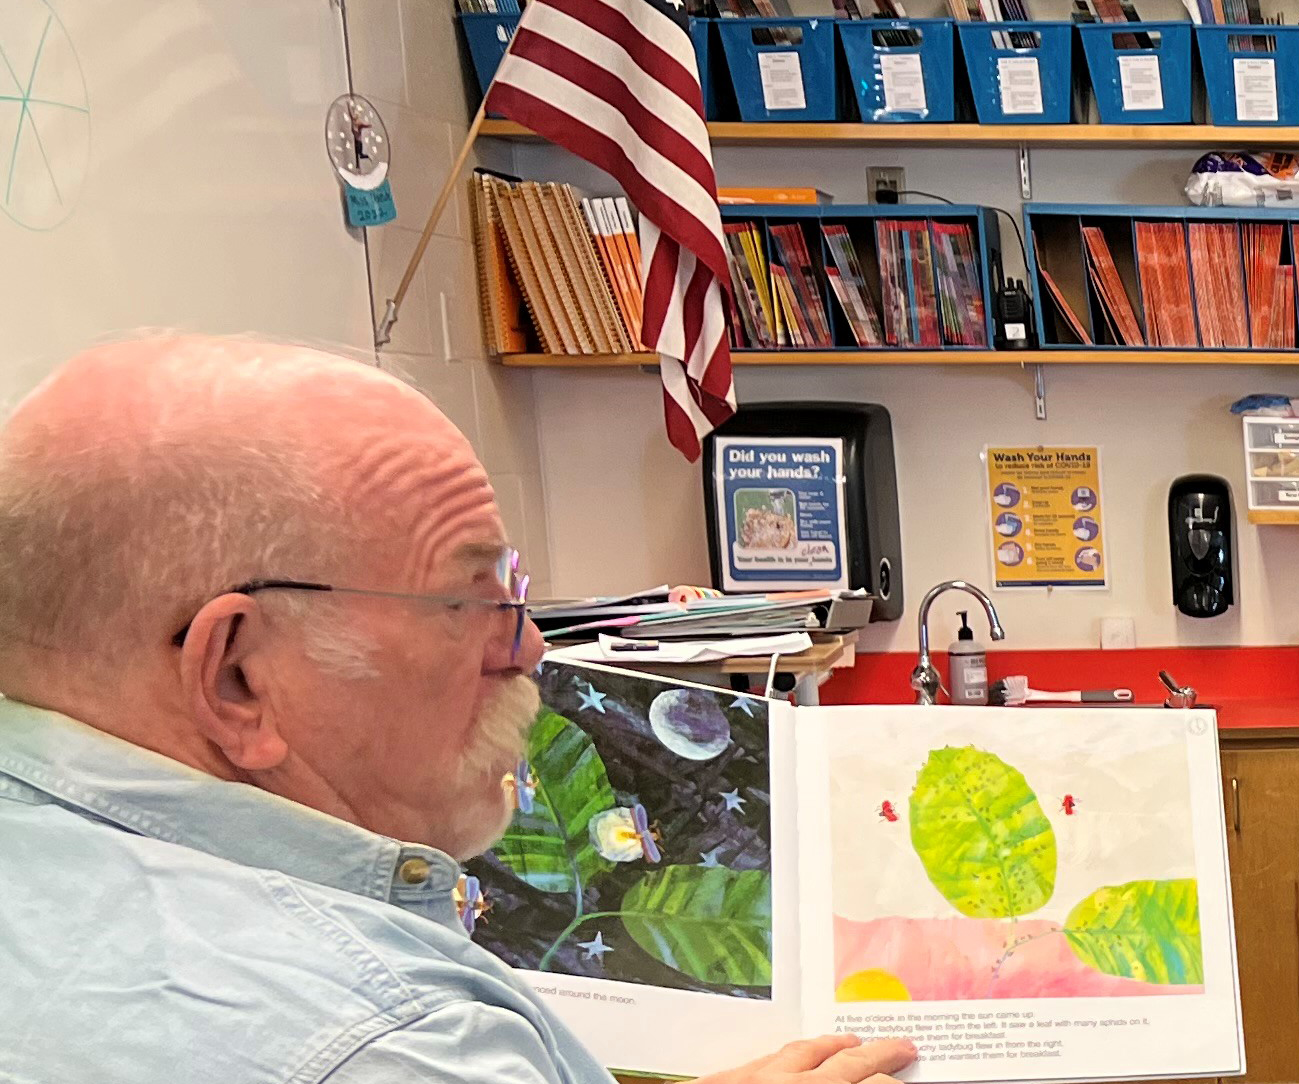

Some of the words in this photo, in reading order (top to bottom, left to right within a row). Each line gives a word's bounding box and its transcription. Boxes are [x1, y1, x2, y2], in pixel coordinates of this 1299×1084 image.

[729, 450, 754, 463] Did
[759, 452, 786, 465] you
[792, 450, 830, 463] wash
[993, 453, 1025, 462] Wash
[1027, 452, 1053, 462] Your
[1056, 452, 1091, 462] Hands
[729, 467, 762, 480] your
[767, 465, 821, 479] hands?
[534, 985, 556, 995] nced
[558, 988, 591, 999] around
[593, 992, 607, 1000] the
[846, 1014, 863, 1022] five
[907, 1013, 922, 1021] the
[923, 1013, 960, 1022] morning
[844, 1025, 876, 1034] friendly
[878, 1024, 914, 1034] ladybug
[1055, 1019, 1072, 1027] with
[1073, 1019, 1098, 1029] many
[1099, 1018, 1128, 1028] aphids
[951, 1032, 964, 1040] for
[938, 1042, 974, 1052] ladybug
[975, 1041, 993, 1049] flew
[1005, 1040, 1026, 1048] from
[929, 1053, 946, 1061] and
[948, 1052, 981, 1060] wanted
[982, 1051, 1005, 1059] them
[1006, 1050, 1018, 1058] for
